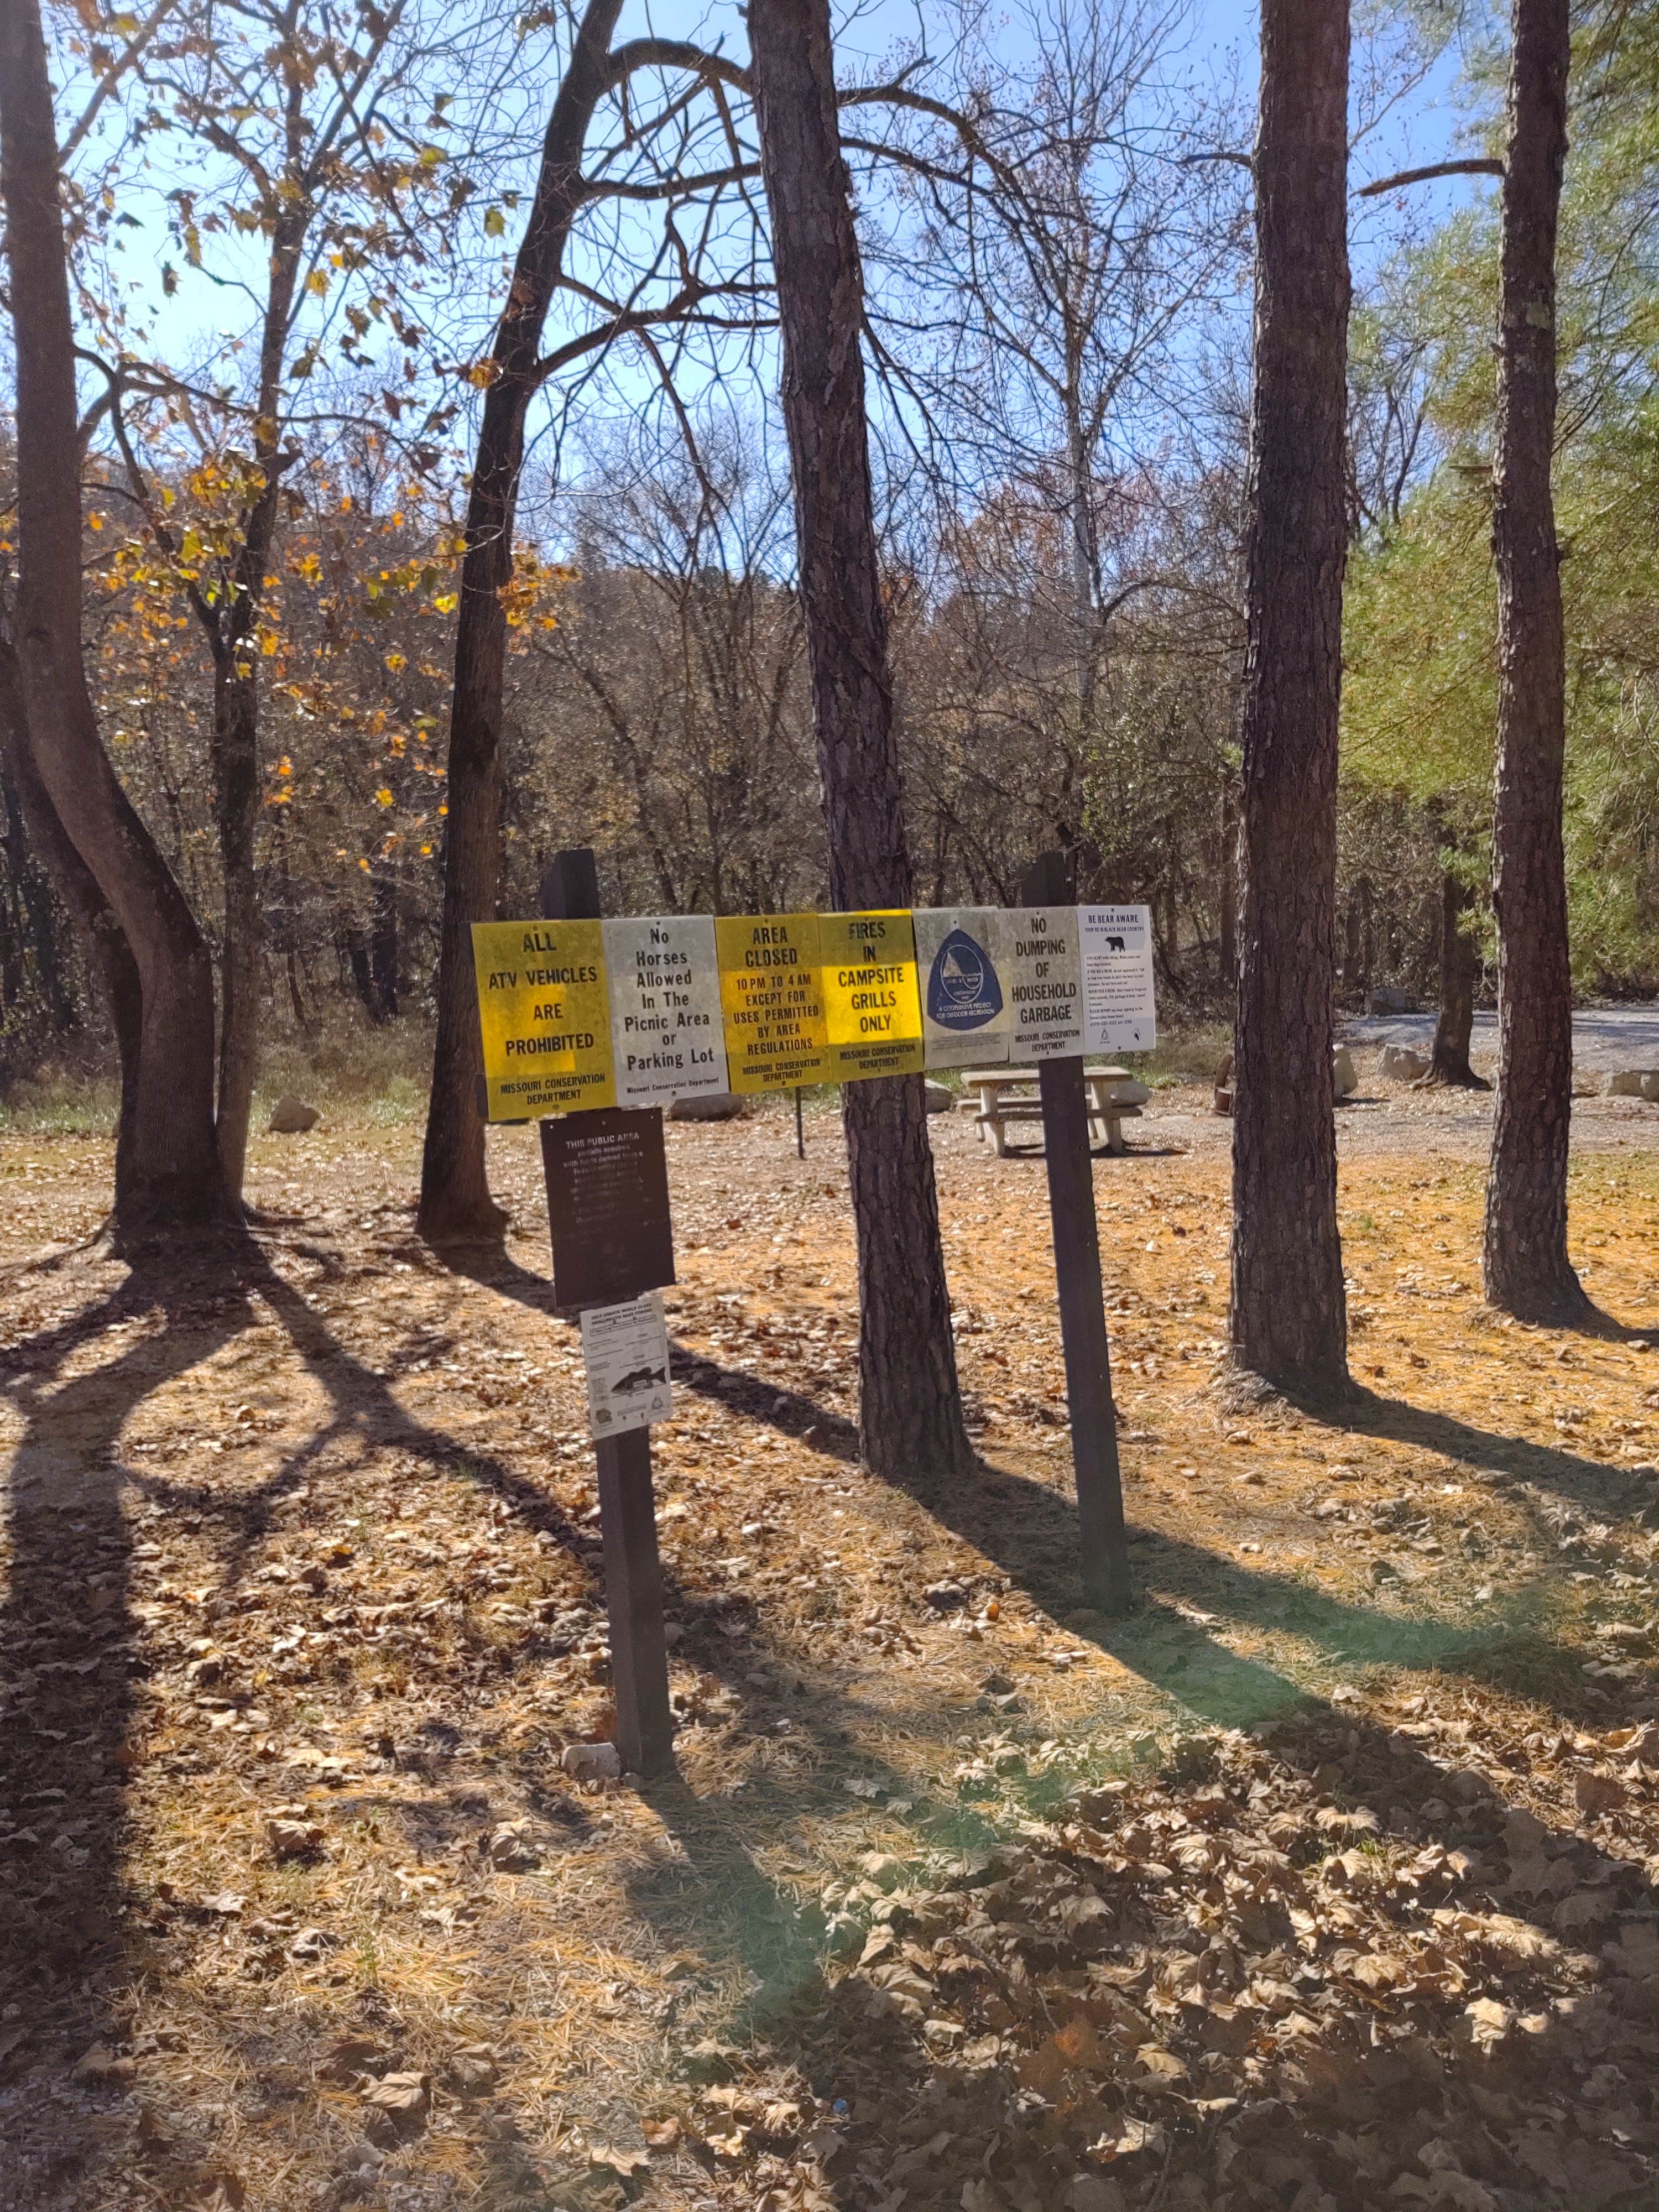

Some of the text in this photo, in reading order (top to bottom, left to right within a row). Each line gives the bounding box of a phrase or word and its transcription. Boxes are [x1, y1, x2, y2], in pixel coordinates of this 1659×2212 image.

[1031, 918, 1047, 934] NO
[1098, 915, 1114, 923] BEAR
[650, 928, 669, 944] No
[753, 926, 787, 945] AREA
[849, 922, 886, 940] FIRES
[523, 933, 557, 953] ALL
[1016, 938, 1066, 957] DUMPING
[637, 951, 687, 967] Horses
[745, 948, 797, 967] CLOSED
[863, 946, 876, 962] IN
[489, 967, 597, 989] ATV VEHICLES
[637, 969, 692, 988] Allowed
[838, 967, 904, 987] CAMPSITE
[1035, 962, 1050, 978] OF
[737, 973, 811, 990] 10 PM TO 4 AM
[641, 991, 689, 1009] In The
[746, 990, 805, 1006] EXCEPT FOR
[851, 991, 896, 1010] GRILLS
[1011, 982, 1076, 1003] HOUSEHOLD
[534, 1004, 564, 1021] ARE
[734, 1005, 818, 1025] USES PERMITTED
[943, 1003, 972, 1011] COOPERATIVE
[1020, 1005, 1072, 1024] GARBAGE
[625, 1012, 709, 1032] Picnic Area
[860, 1014, 891, 1032] ONLY
[662, 1032, 676, 1046] or
[758, 1023, 800, 1039] BY AREA
[1015, 1032, 1039, 1044] MISSOURI
[1042, 1029, 1080, 1041] CONSERVATION
[505, 1032, 594, 1056] PROHIBITED
[747, 1038, 812, 1056] REGULATIONS
[840, 1044, 915, 1060] MISSOURI CONSERVATION
[1031, 1041, 1065, 1053] DEPARTMENT
[627, 1048, 714, 1071] Parking Lot
[743, 1058, 820, 1075] MISSOURI CONSERVATION
[859, 1056, 899, 1070] DEPARTMENT
[500, 1073, 606, 1095] MISSOURI CONSERVATION
[627, 1077, 718, 1094] Missouri Conservation Department
[763, 1071, 802, 1083] DEPARTMENT
[526, 1089, 581, 1105] DEPARTMENT
[587, 1135, 615, 1146] PUBLIC
[618, 1133, 640, 1141] AREA
